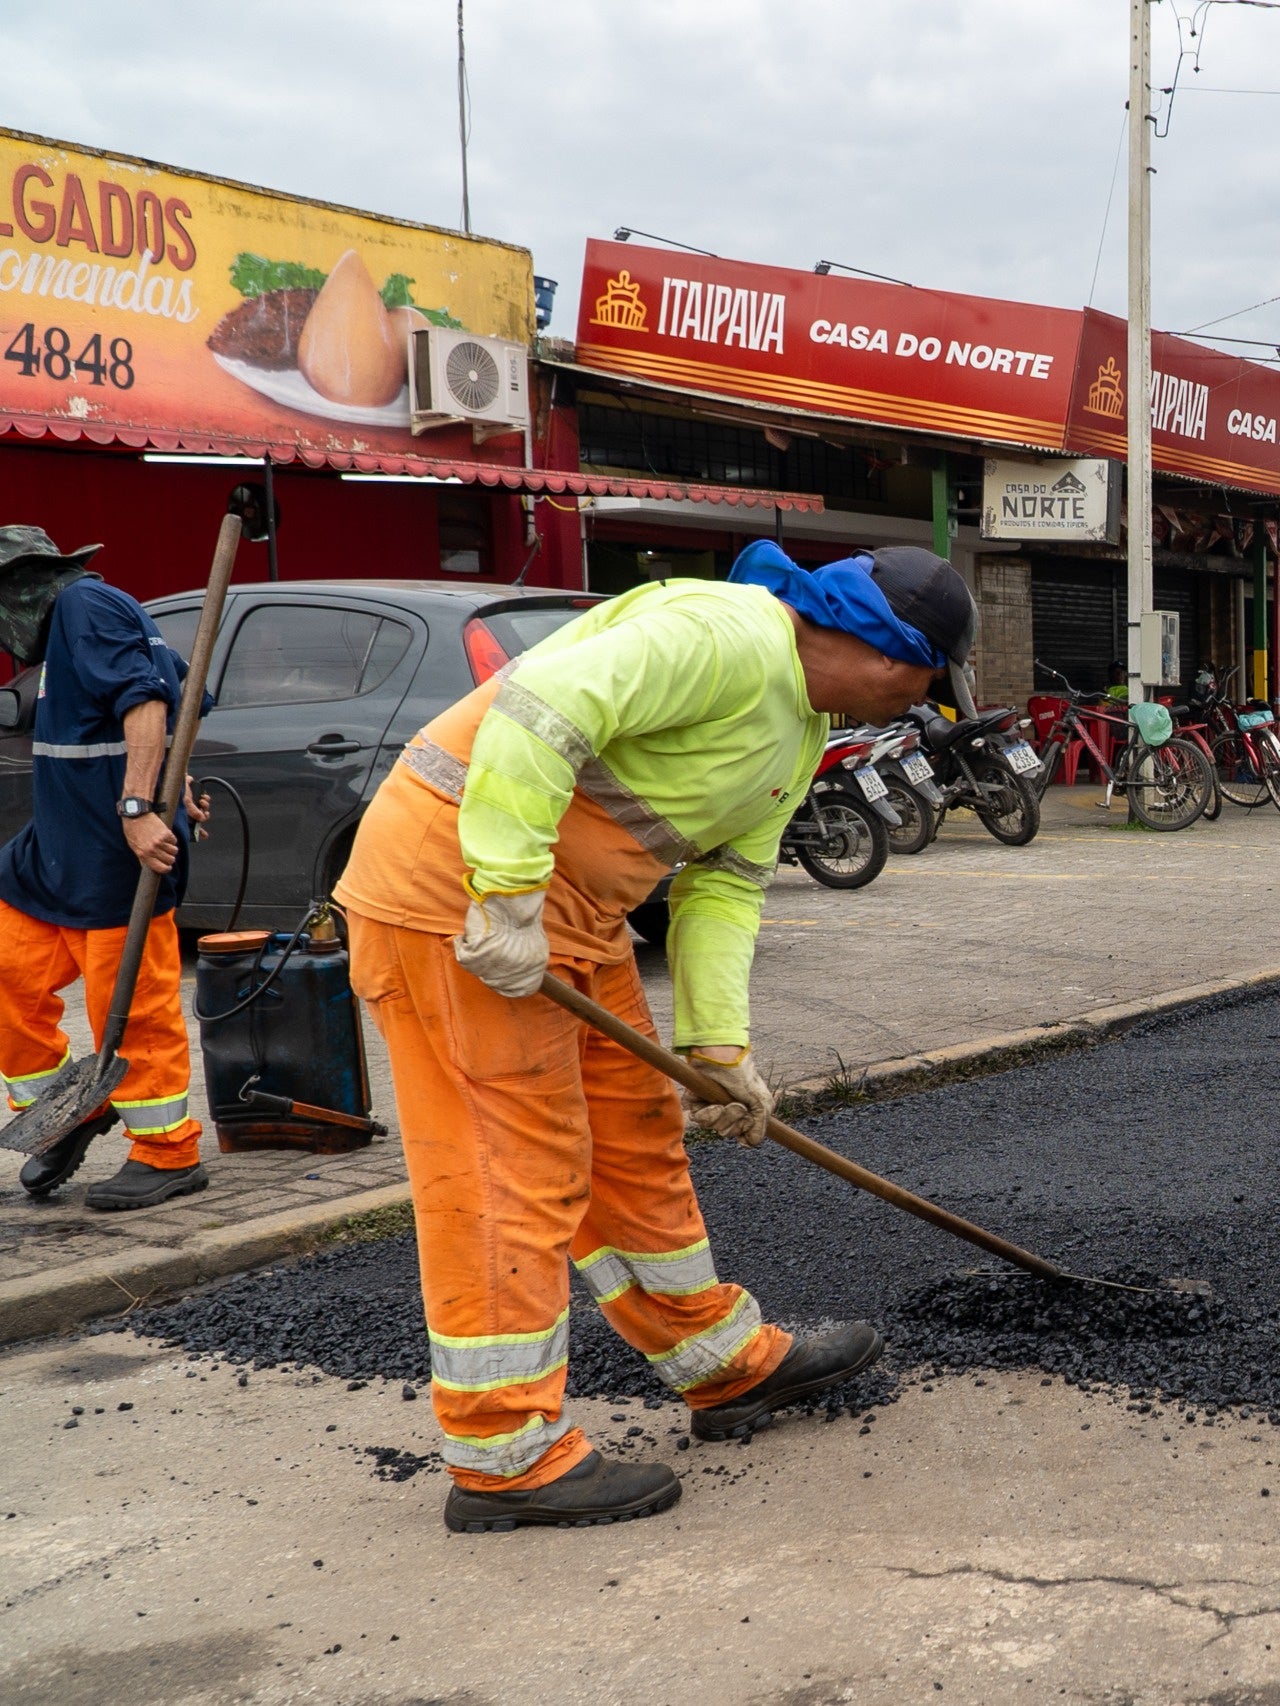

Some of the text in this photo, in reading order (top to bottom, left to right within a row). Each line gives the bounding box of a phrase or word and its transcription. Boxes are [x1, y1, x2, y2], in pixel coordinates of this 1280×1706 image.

[0, 164, 196, 271] GADOS
[657, 276, 786, 355] ITAIPAVA
[4, 323, 135, 390] 4848
[809, 319, 1054, 380] CASA DO NORTE
[1227, 408, 1277, 444] CASA
[1002, 496, 1085, 519] NORTE
[1006, 484, 1046, 494] CASA DO
